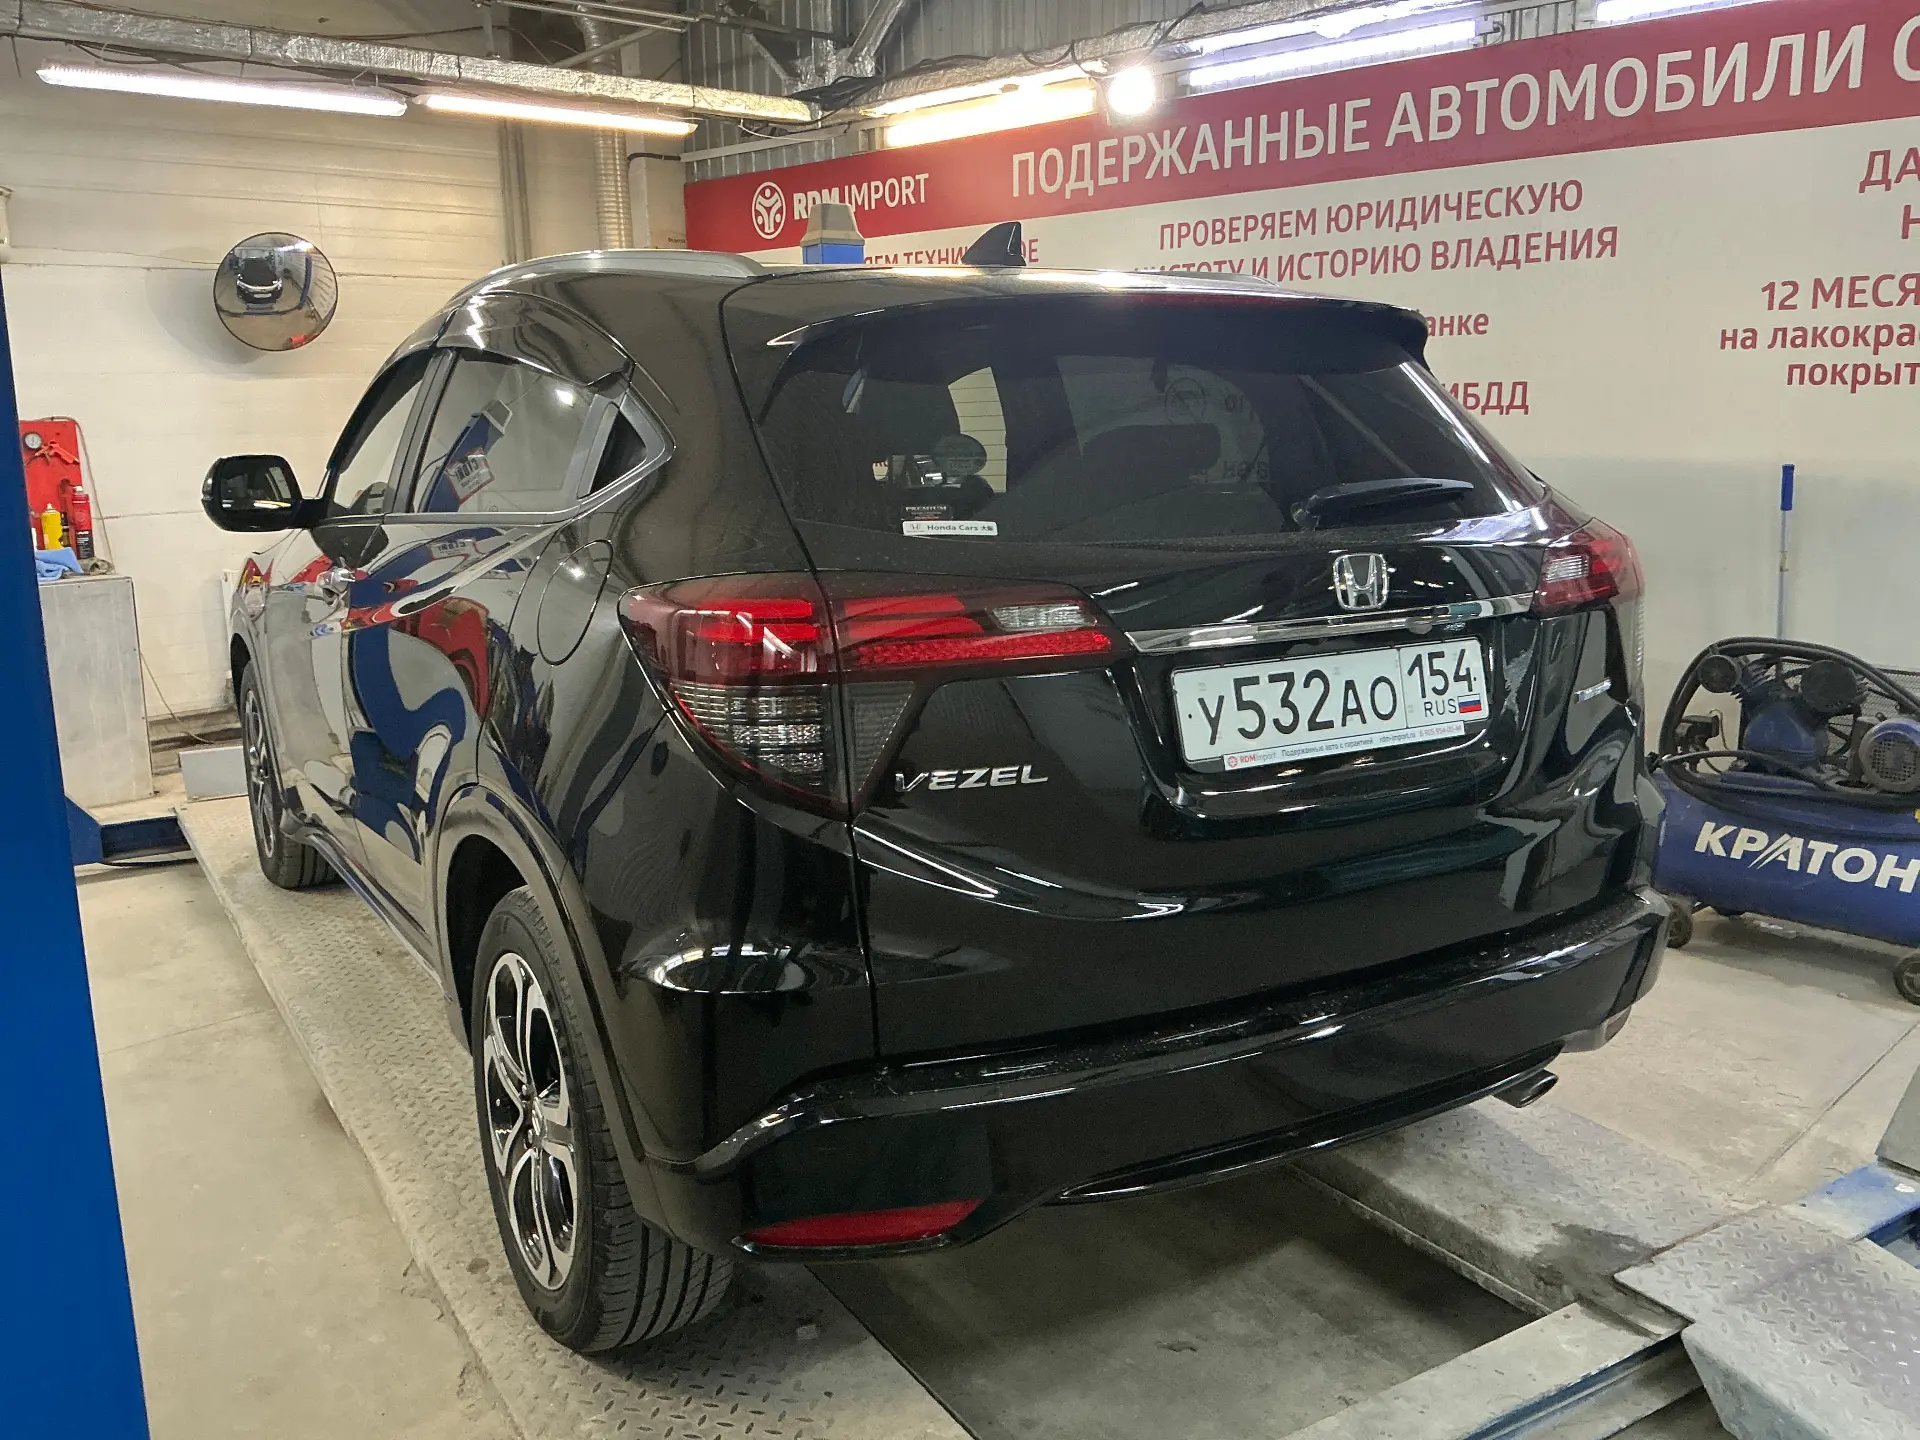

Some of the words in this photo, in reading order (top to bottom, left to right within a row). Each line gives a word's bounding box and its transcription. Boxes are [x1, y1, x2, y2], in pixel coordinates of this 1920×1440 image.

[1012, 98, 1371, 200] ПОДЕРЖАННЫЕ
[1385, 24, 1866, 148] АВТОМОБИЛИ
[1858, 147, 1920, 194] ДА
[1159, 207, 1317, 251] ПРОВЕРЯЕМ
[1326, 179, 1583, 234] ЮРИДИЧЕСКУЮ
[1277, 242, 1421, 283] ИСТОРИЮ
[1431, 226, 1619, 272] ВЛАДЕНИЯ
[1761, 280, 1800, 311] 12
[1811, 272, 1920, 310] МЕСЯ
[1424, 312, 1489, 338] анке
[1720, 326, 1759, 351] на
[1767, 322, 1920, 356] лакокра
[1786, 361, 1920, 394] покрыт
[1407, 648, 1475, 699] 154
[1423, 697, 1458, 719] RUS
[1281, 746, 1324, 758] Подержанные
[895, 764, 1049, 792] VEZEL
[1694, 821, 1920, 893] КРАТОН
